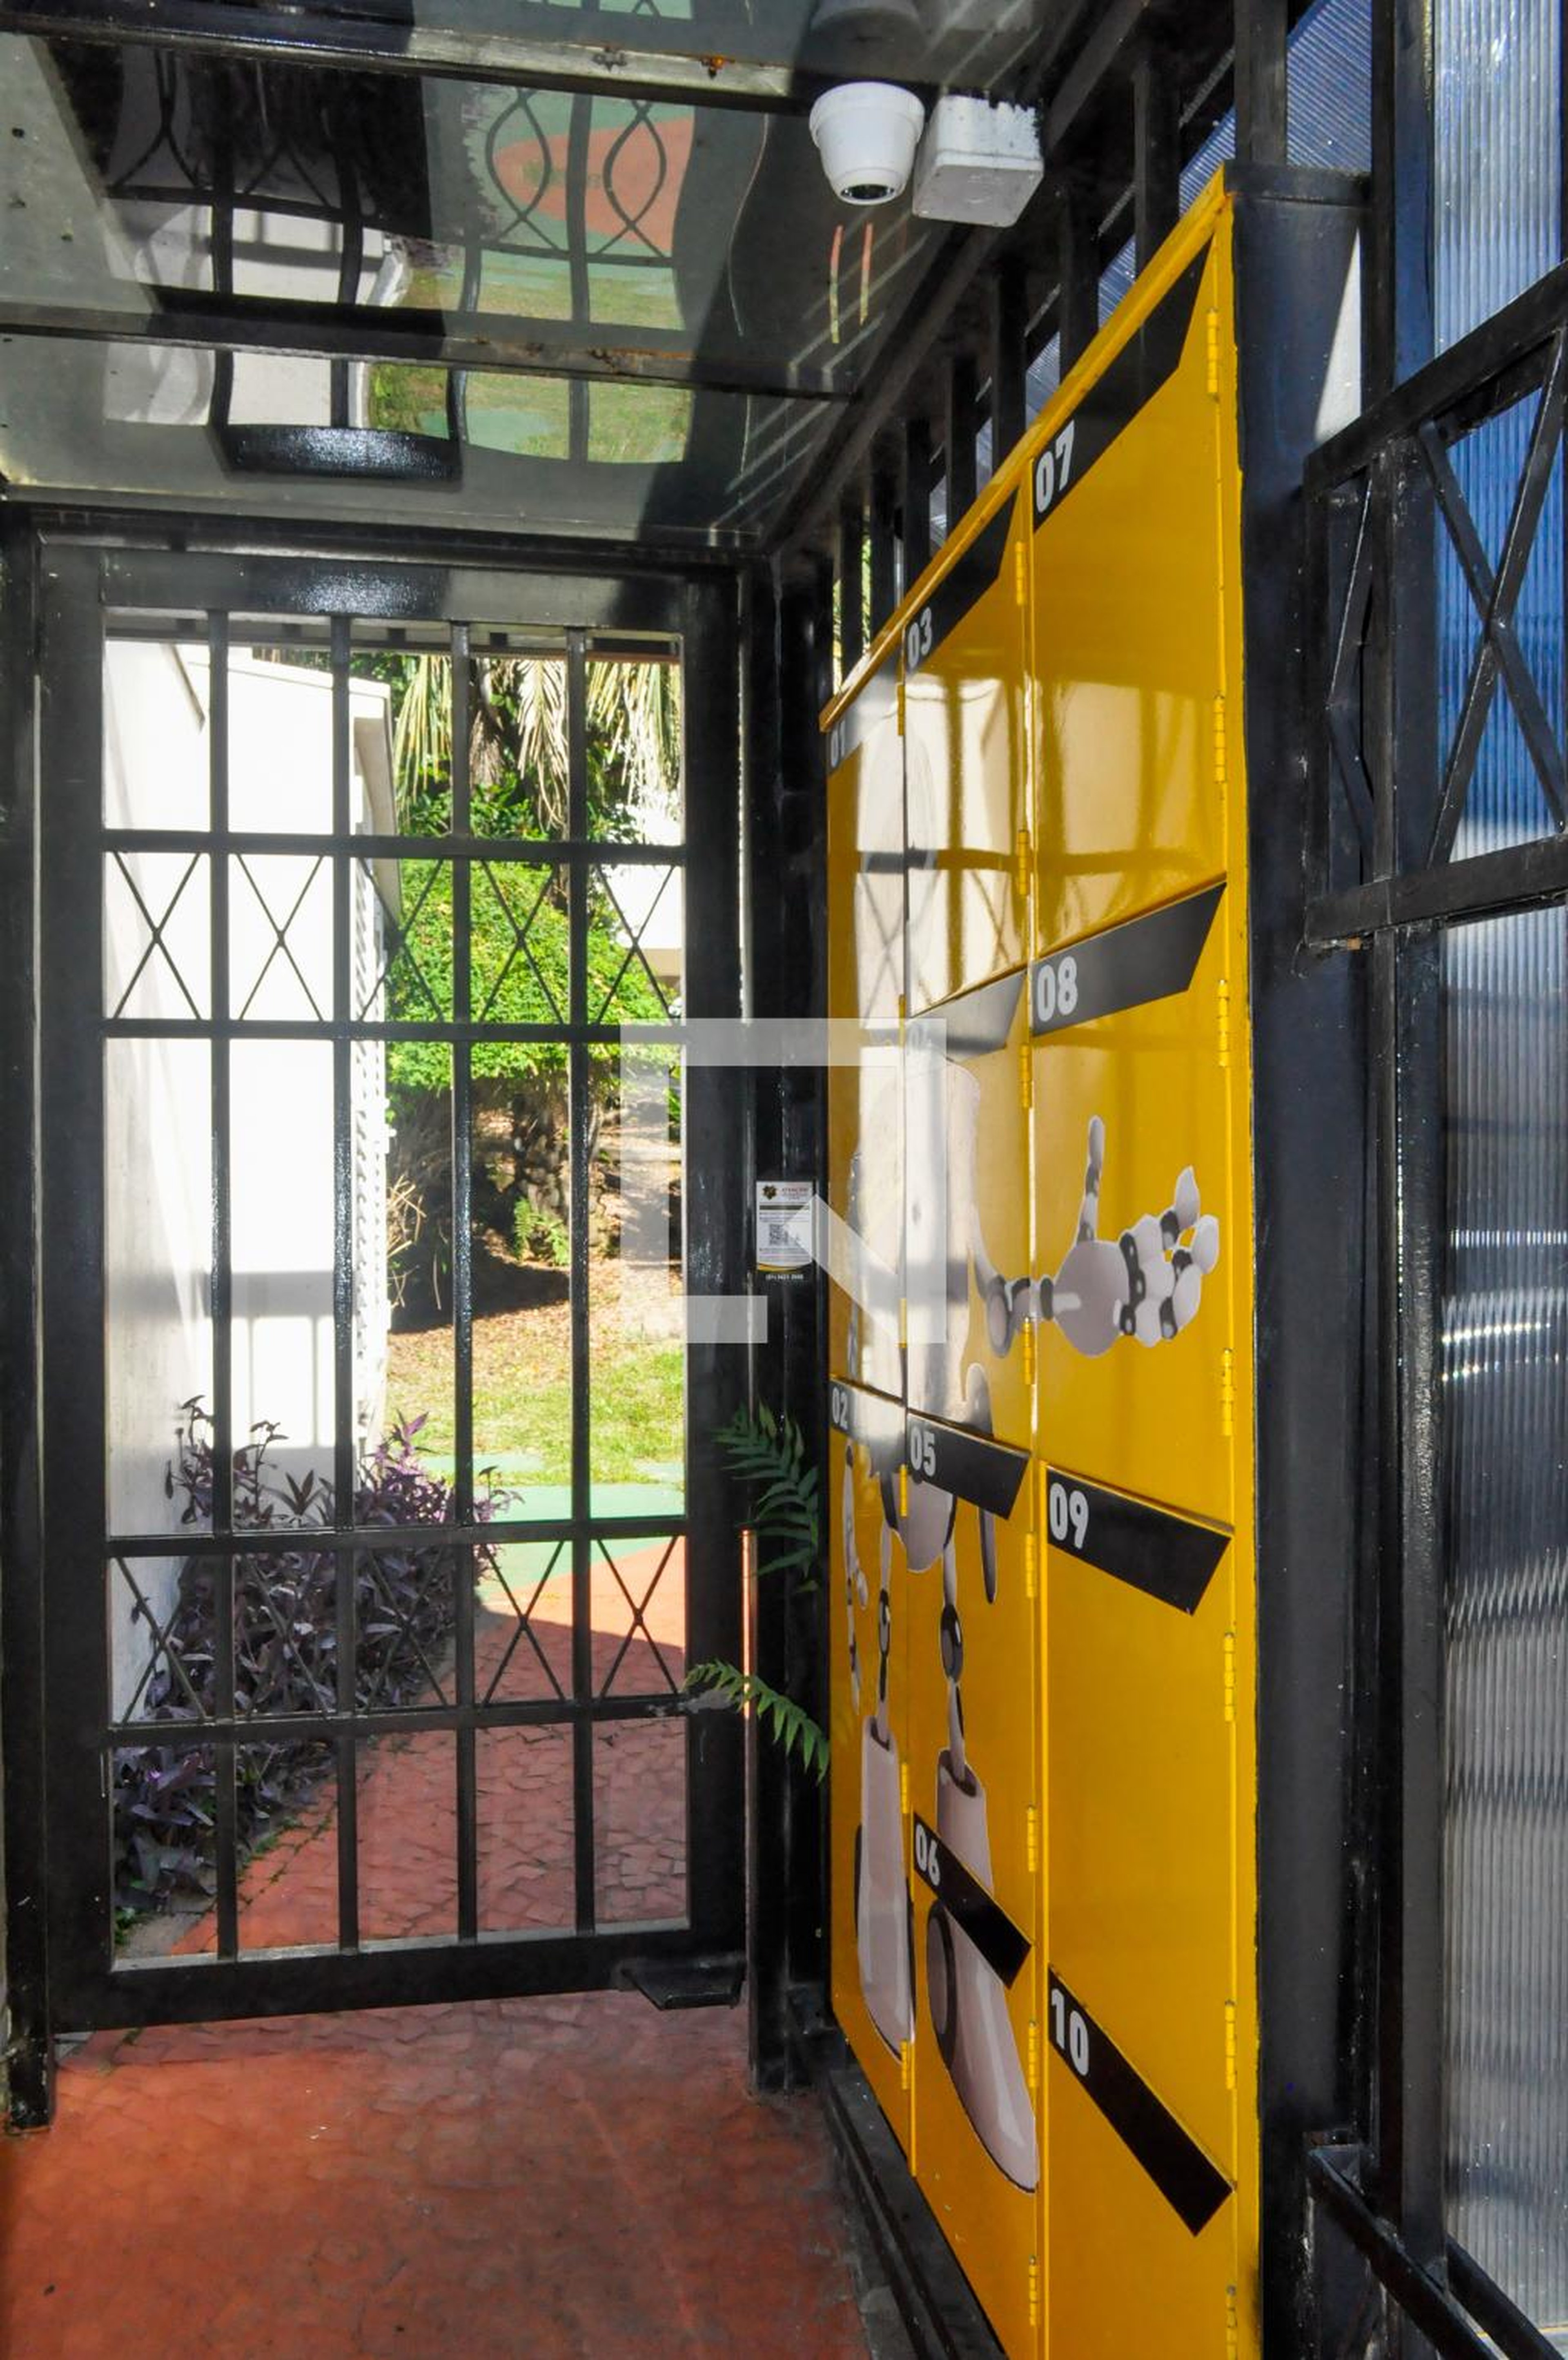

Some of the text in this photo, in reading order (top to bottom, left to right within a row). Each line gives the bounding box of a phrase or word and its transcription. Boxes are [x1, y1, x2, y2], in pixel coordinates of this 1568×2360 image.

[1036, 420, 1074, 512] 07
[908, 607, 932, 669] 03
[831, 720, 846, 768] 01
[1038, 956, 1078, 1022] 08
[833, 1387, 848, 1430] 02
[911, 1427, 936, 1477] 05
[1050, 1482, 1089, 1549] 09
[915, 1823, 940, 1886] 06
[1051, 1988, 1089, 2076] 10
